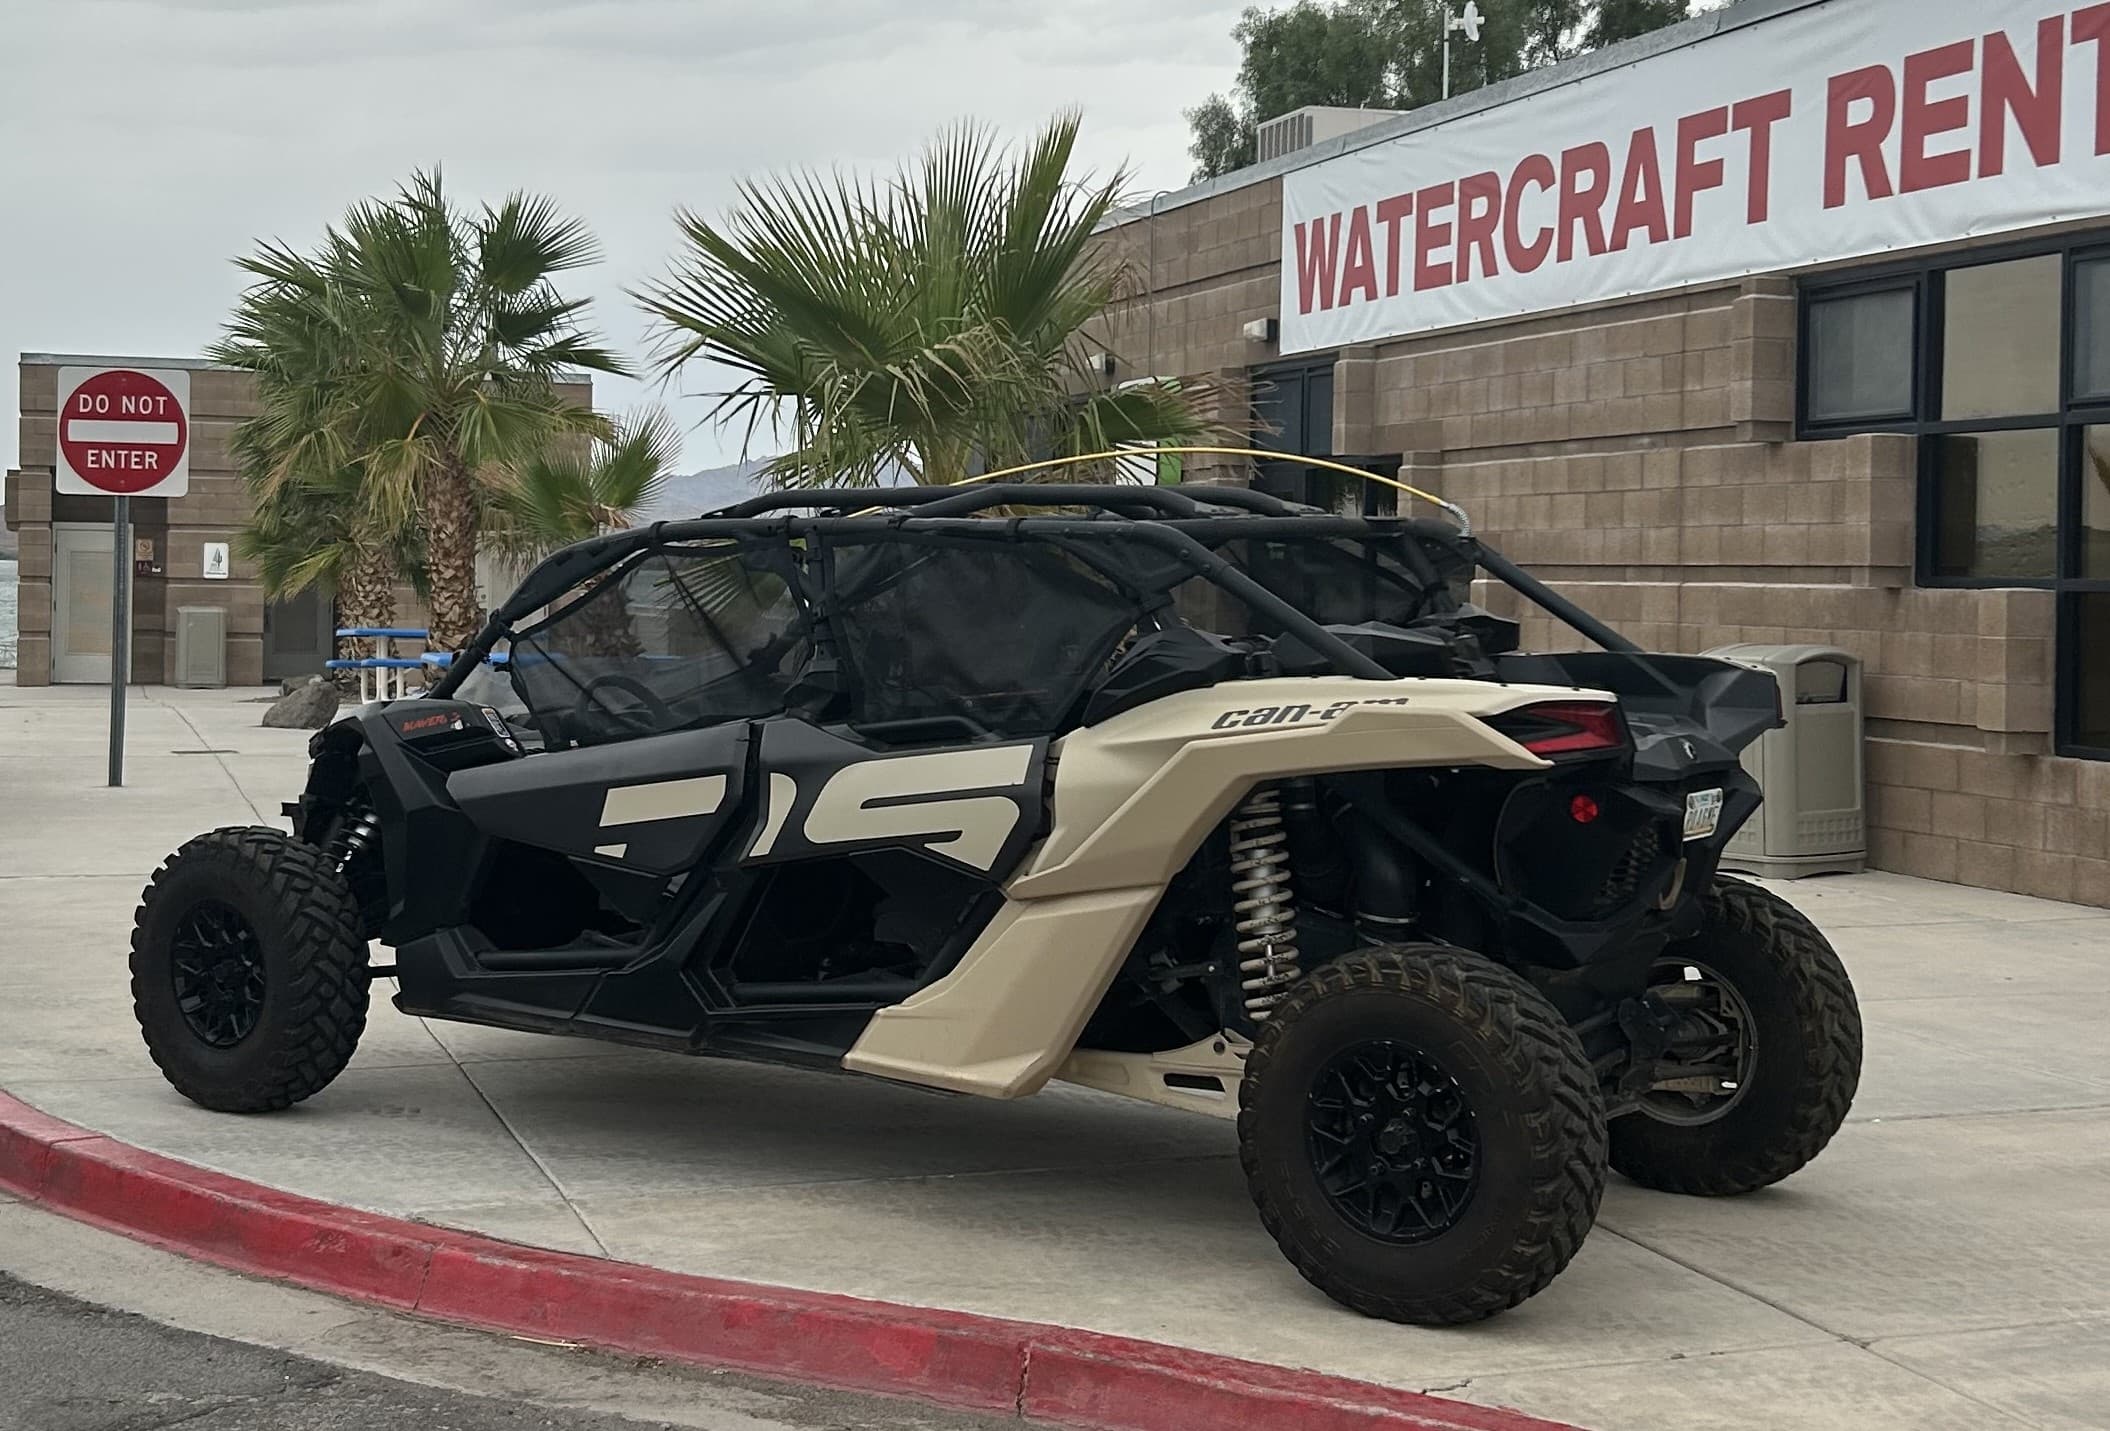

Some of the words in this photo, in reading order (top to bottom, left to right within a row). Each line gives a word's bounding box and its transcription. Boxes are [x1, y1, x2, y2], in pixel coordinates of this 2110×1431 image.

[1294, 88, 1792, 314] WATERCRAFT
[79, 394, 109, 414] DO
[121, 395, 168, 416] NOT
[87, 449, 158, 470] ENTER
[1211, 698, 1409, 730] can-a
